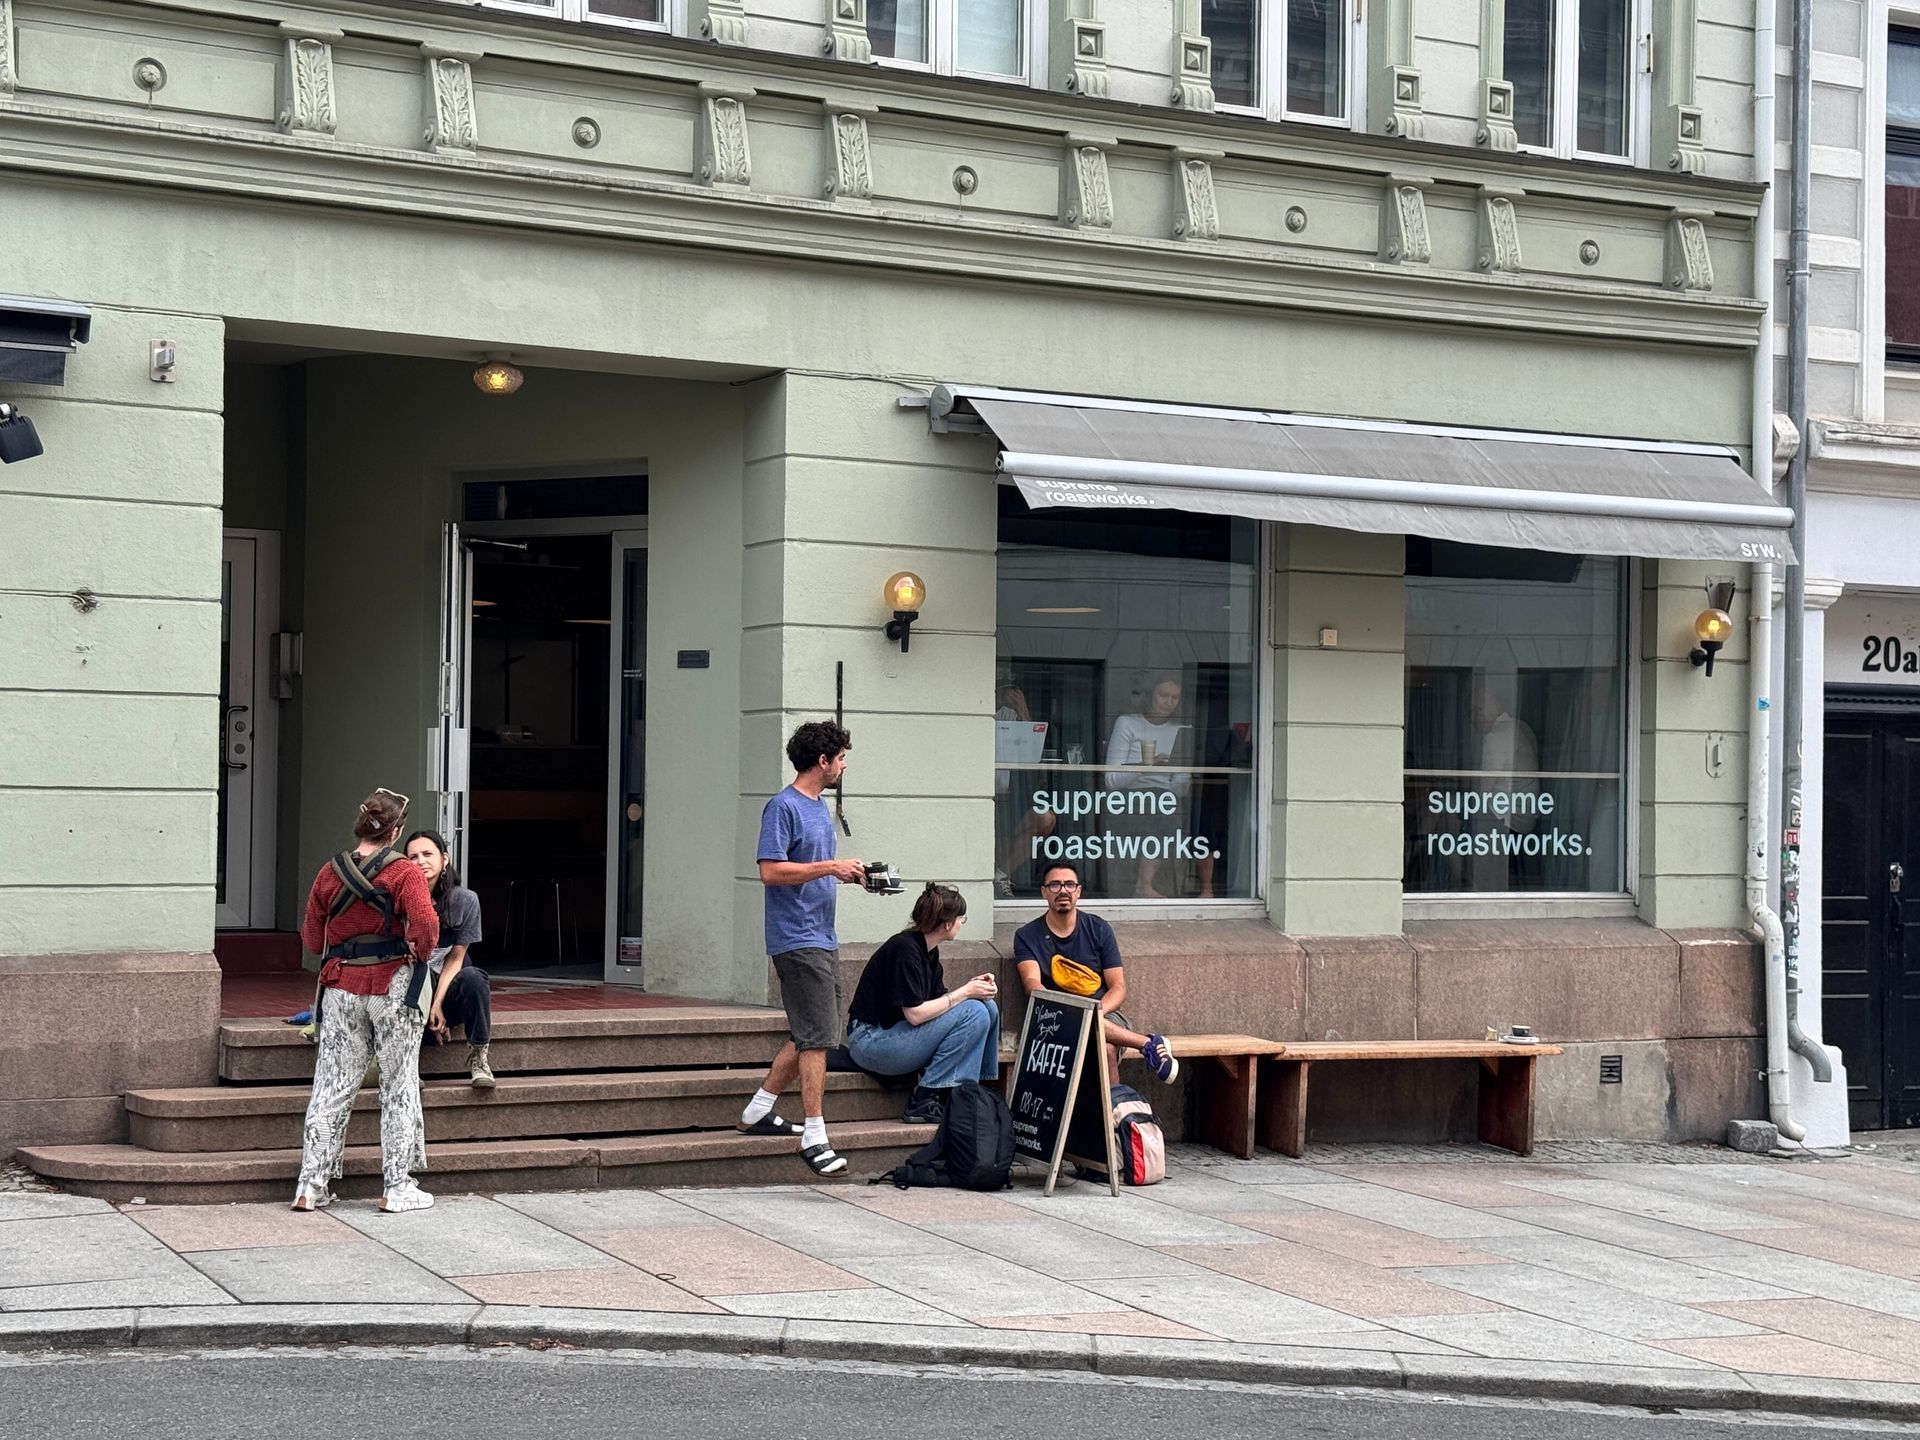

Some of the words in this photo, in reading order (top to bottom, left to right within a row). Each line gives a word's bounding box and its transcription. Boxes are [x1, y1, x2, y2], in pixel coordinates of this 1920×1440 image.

[1036, 479, 1118, 491] supreme
[1045, 490, 1155, 505] roastworks.
[1740, 542, 1782, 560] srw.
[1861, 635, 1920, 674] 20a
[1032, 790, 1177, 821] supreme
[1428, 790, 1554, 821] supreme
[1031, 828, 1221, 860] roastworks.
[1427, 827, 1592, 857] roastworks.
[1026, 1039, 1070, 1079] KAFFE
[1012, 1120, 1038, 1135] supreme
[1015, 1135, 1042, 1152] astworks.
